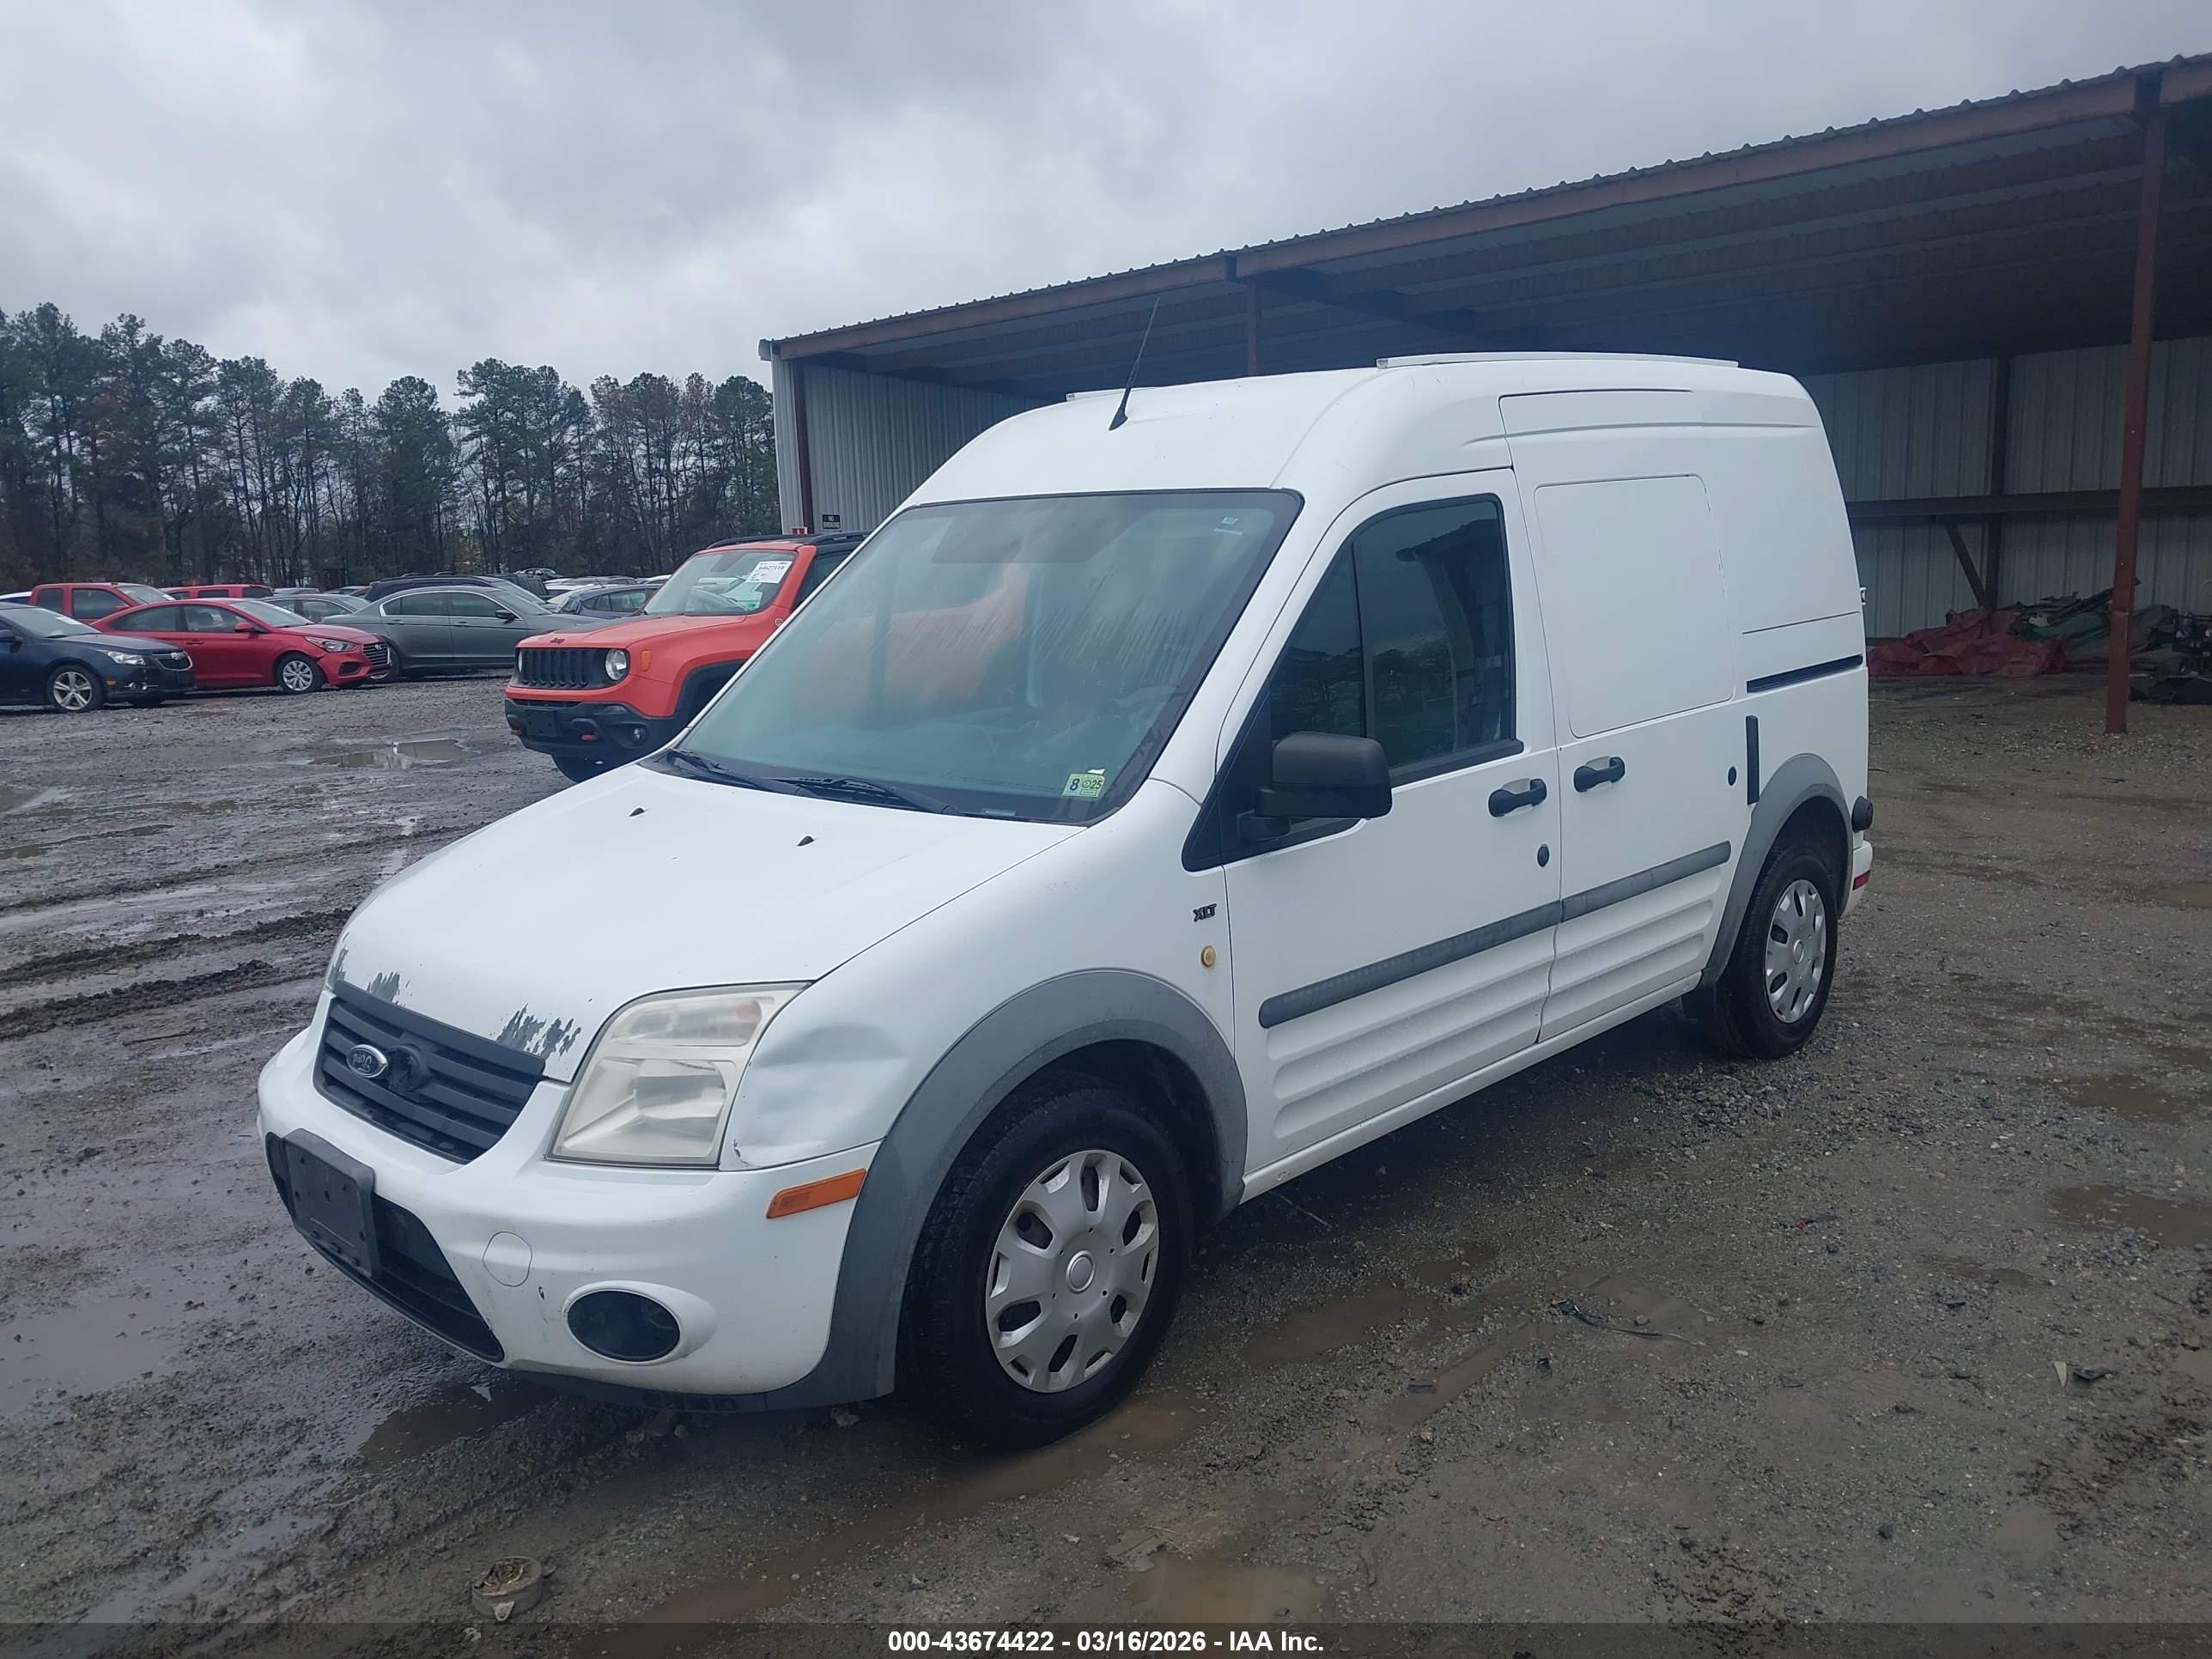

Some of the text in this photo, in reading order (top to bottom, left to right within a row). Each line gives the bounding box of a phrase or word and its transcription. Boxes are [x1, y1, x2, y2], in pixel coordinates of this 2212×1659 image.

[1069, 778, 1103, 791] 8 25
[1193, 902, 1218, 923] XLT
